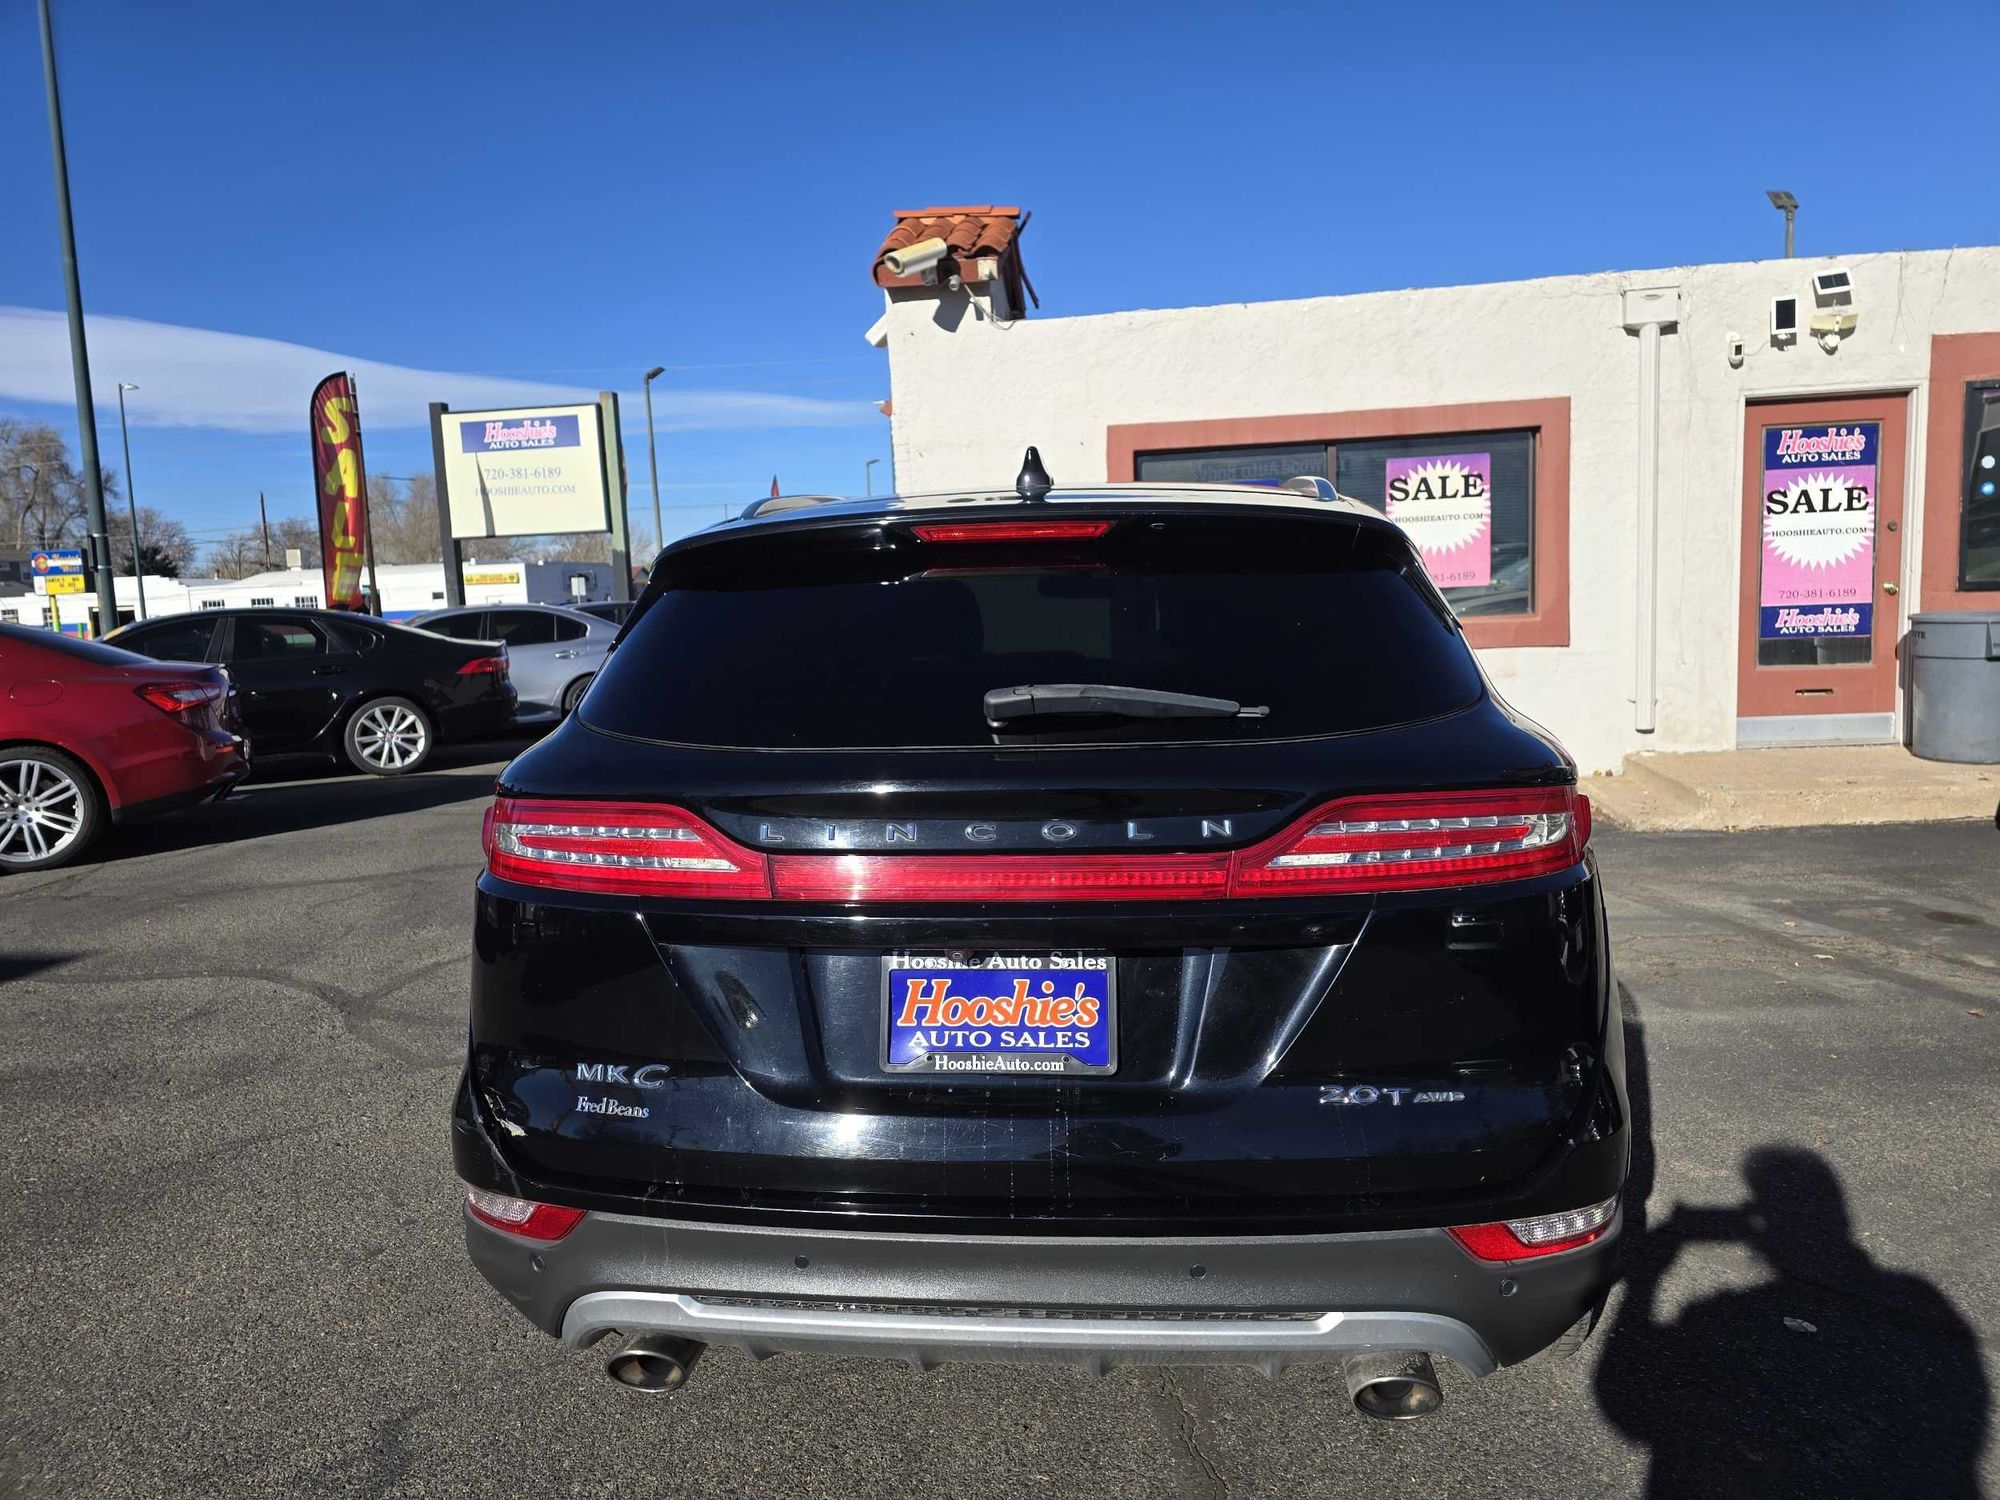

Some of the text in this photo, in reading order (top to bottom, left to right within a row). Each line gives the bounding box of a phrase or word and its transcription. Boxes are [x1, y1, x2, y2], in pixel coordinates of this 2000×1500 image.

[484, 420, 557, 443] Hooshie's
[489, 438, 555, 450] AUTO SALES
[1776, 428, 1866, 455] Hooshie's
[1782, 450, 1861, 463] AUTO SALES
[484, 466, 562, 481] 720-381-6189
[1389, 474, 1485, 502] SALE
[320, 396, 364, 601] SALE
[1766, 486, 1870, 515] SALE
[1394, 512, 1483, 523] HOOSHIEAUTO.COM
[1772, 527, 1868, 537] HOOSHIEAUTO.COM
[1433, 570, 1476, 582] 81-6189
[1779, 588, 1857, 599] 720-381-6189
[1775, 608, 1860, 628] Hooshie's
[1780, 624, 1856, 634] AUTO SALES
[759, 819, 1234, 842] LINCOLN
[891, 951, 1107, 970] Hoose Auto Sales
[896, 979, 1101, 1029] Hooshie's
[908, 1030, 1091, 1049] AUTO SALES
[934, 1055, 1065, 1072] HooshieAuto.com
[576, 1063, 670, 1089] MKC
